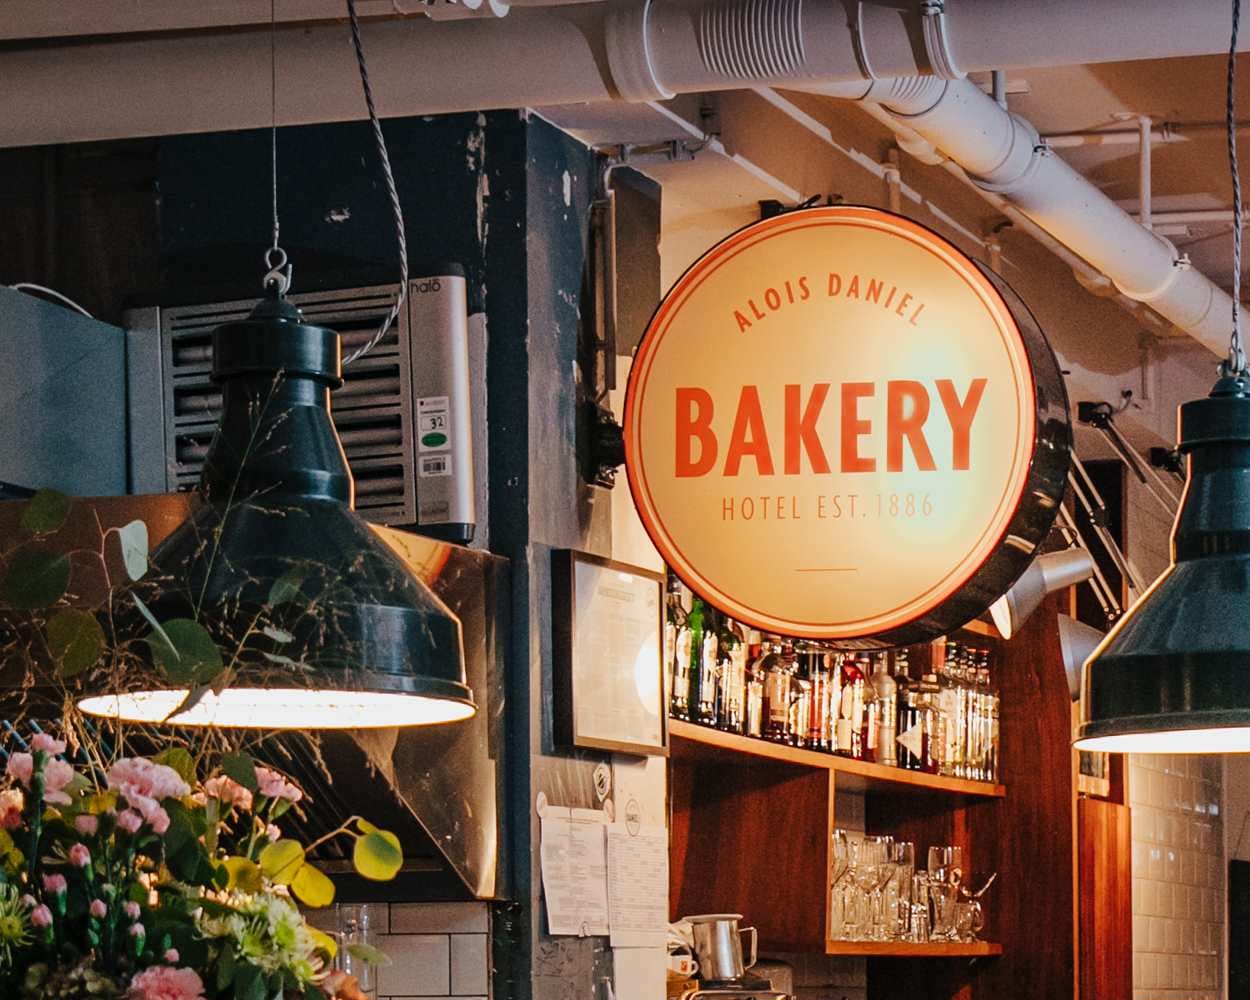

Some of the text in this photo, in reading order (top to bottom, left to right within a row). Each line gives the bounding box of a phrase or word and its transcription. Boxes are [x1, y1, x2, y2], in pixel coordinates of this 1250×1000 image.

[733, 272, 926, 334] ALOIS DANIEL
[674, 377, 989, 479] BAKERY
[721, 493, 933, 521] HOTEL EST. 1886
